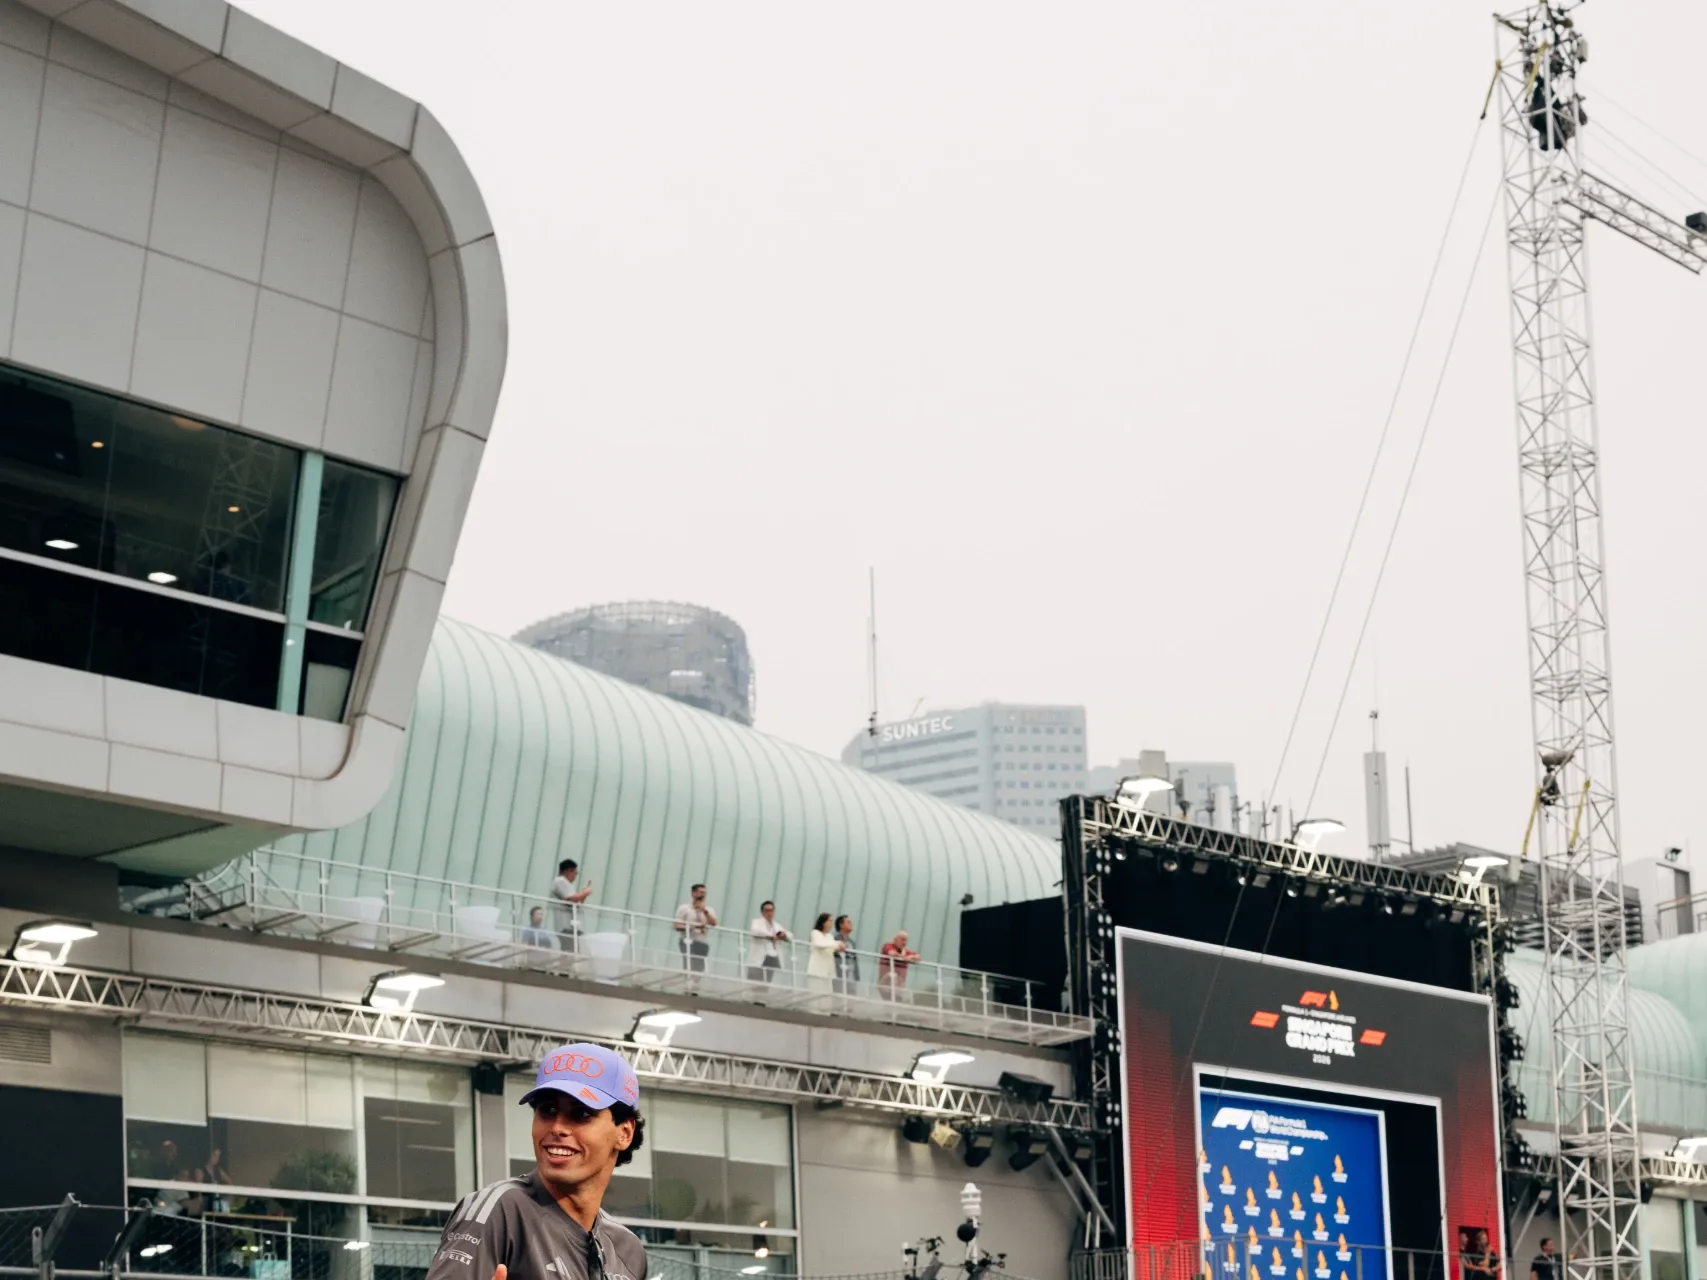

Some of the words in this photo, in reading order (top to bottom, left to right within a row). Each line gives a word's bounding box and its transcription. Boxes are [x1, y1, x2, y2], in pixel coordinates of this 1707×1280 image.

[883, 716, 954, 742] SUNTEC
[1287, 1016, 1352, 1042] SINGAPORE
[1286, 1032, 1328, 1053] GRAND
[1328, 1038, 1355, 1057] PRIX
